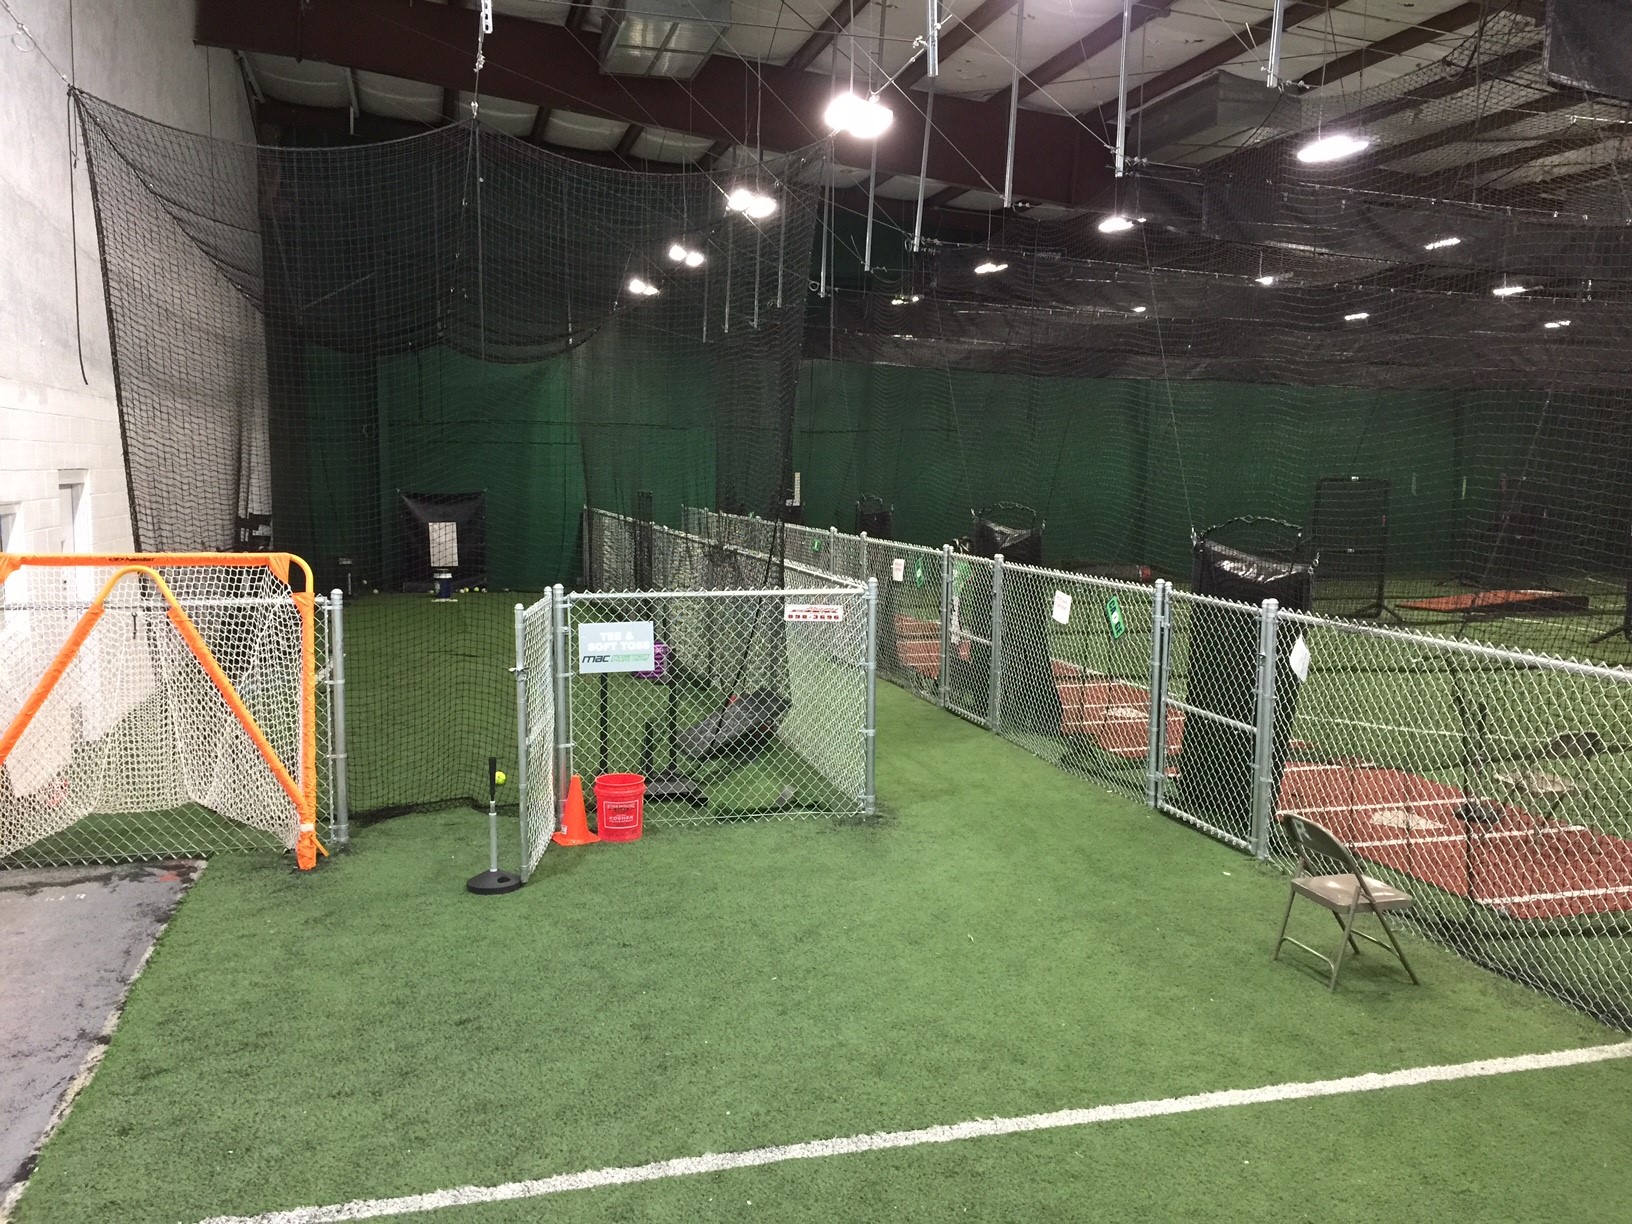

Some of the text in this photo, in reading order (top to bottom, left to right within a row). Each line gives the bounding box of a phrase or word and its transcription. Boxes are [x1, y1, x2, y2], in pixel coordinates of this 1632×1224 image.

[599, 630, 635, 641] TEE &
[587, 641, 618, 652] SOFT
